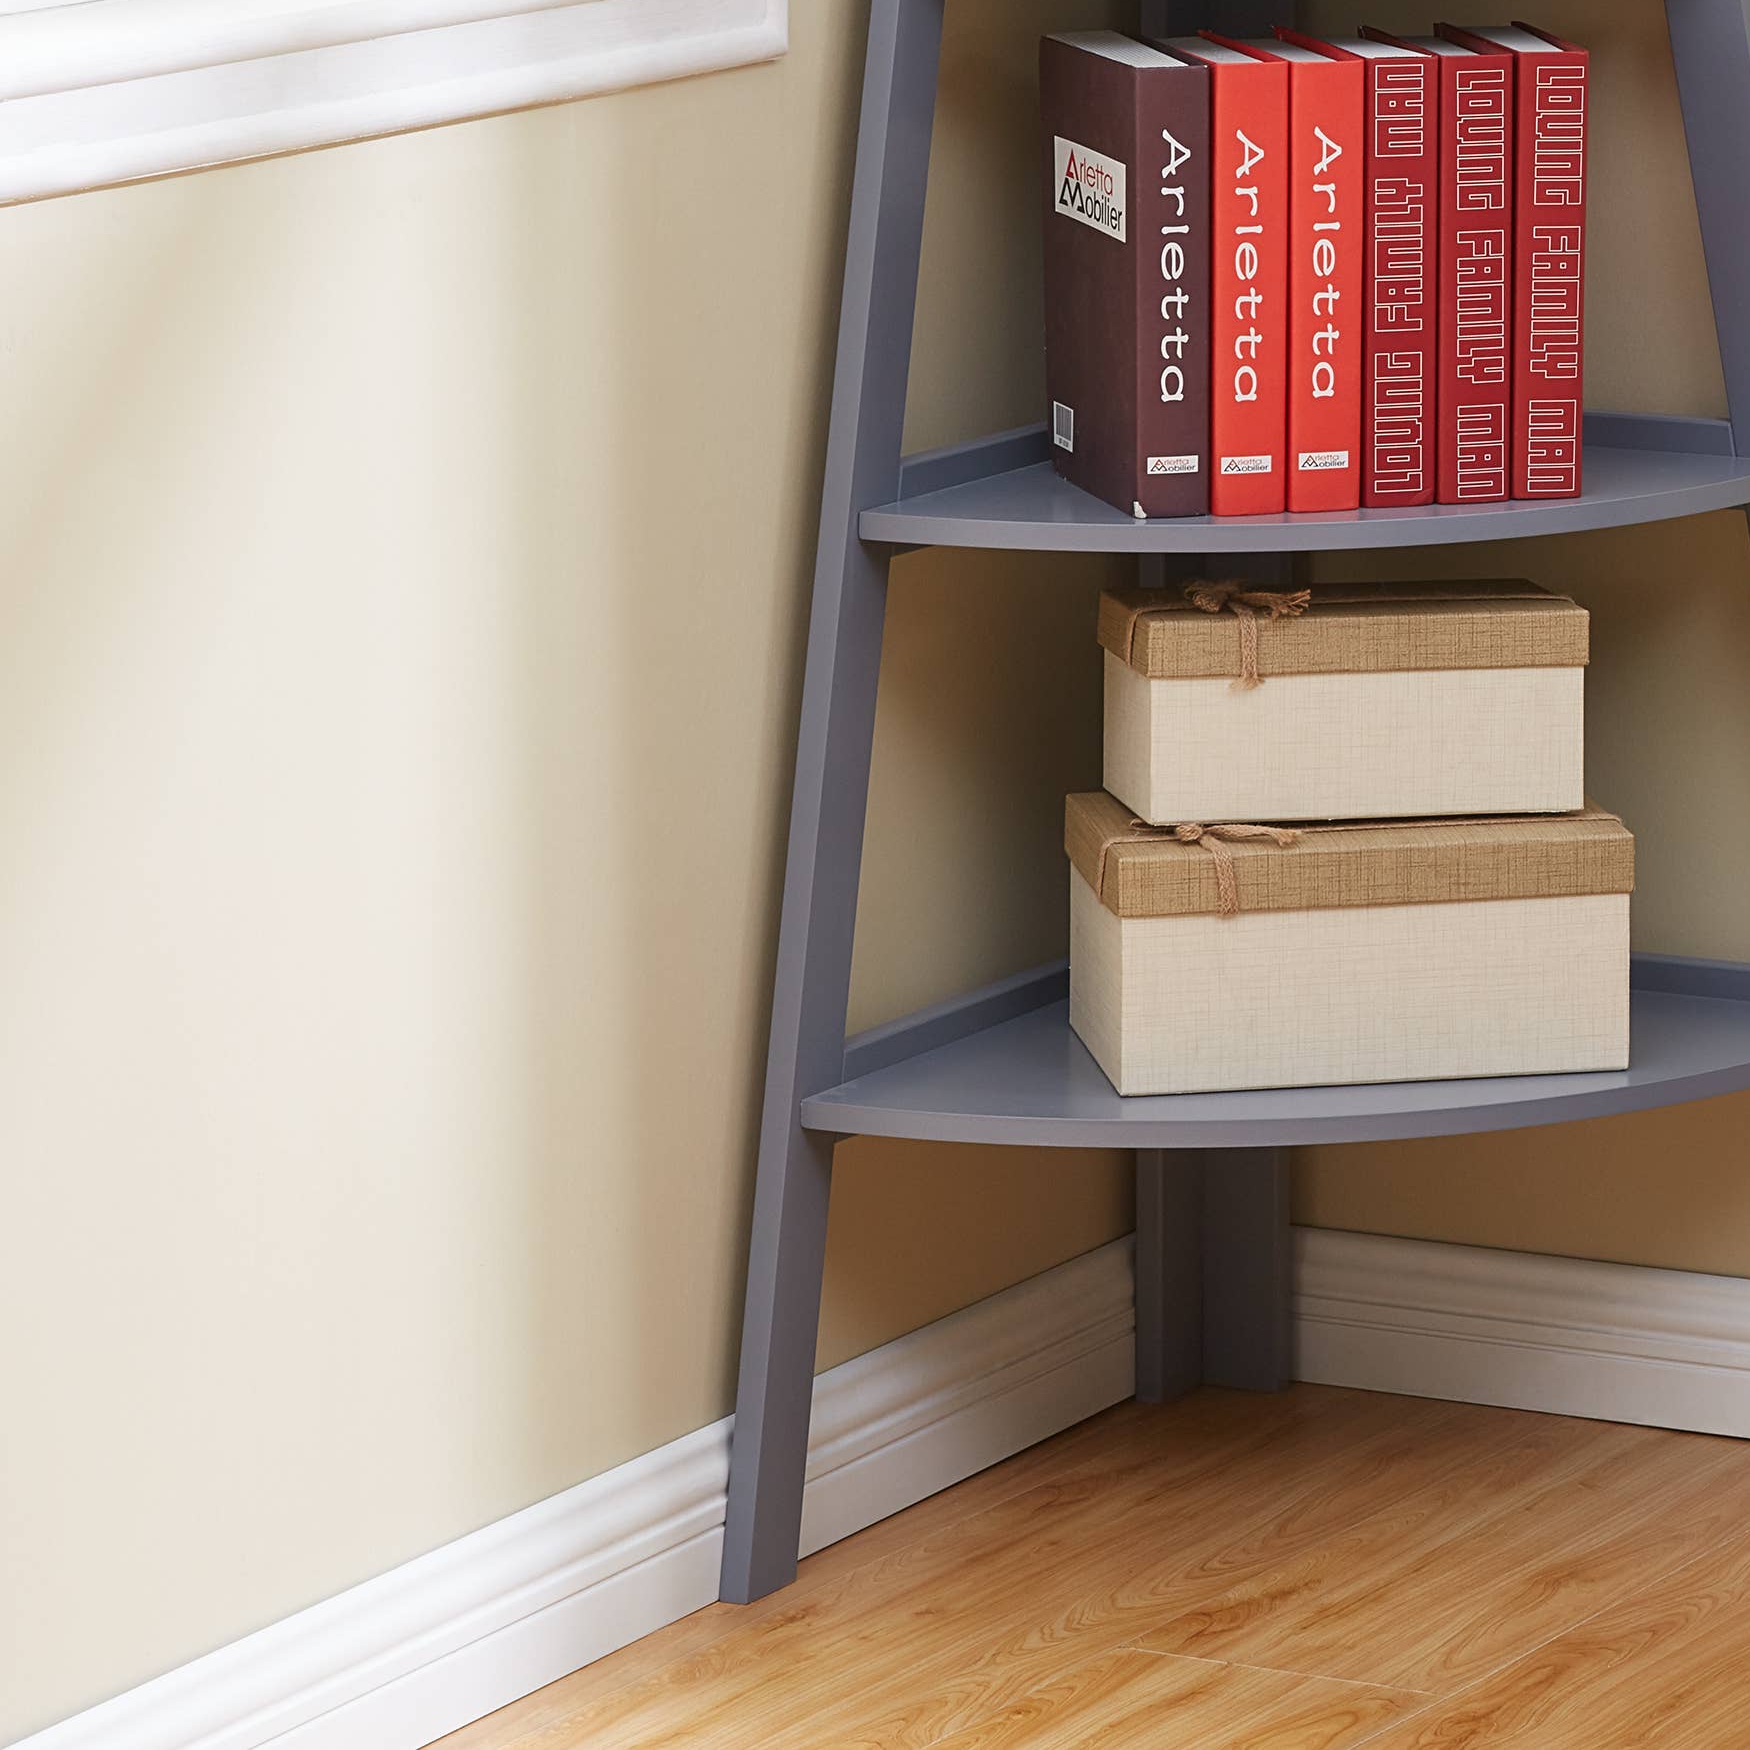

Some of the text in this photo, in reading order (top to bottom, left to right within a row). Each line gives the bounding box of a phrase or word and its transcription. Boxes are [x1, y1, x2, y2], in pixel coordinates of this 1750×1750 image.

[1058, 177, 1123, 232] Mobilier
[1066, 148, 1113, 196] Arletta
[1161, 129, 1191, 402] Arletta
[1235, 129, 1264, 402] Arletta
[1312, 126, 1342, 397] Arletta
[1375, 64, 1423, 493] LOVING FAMILY MAN
[1456, 69, 1504, 498] LOVING FAMILY MAN
[1528, 66, 1584, 492] LOVING FAMILY MAN
